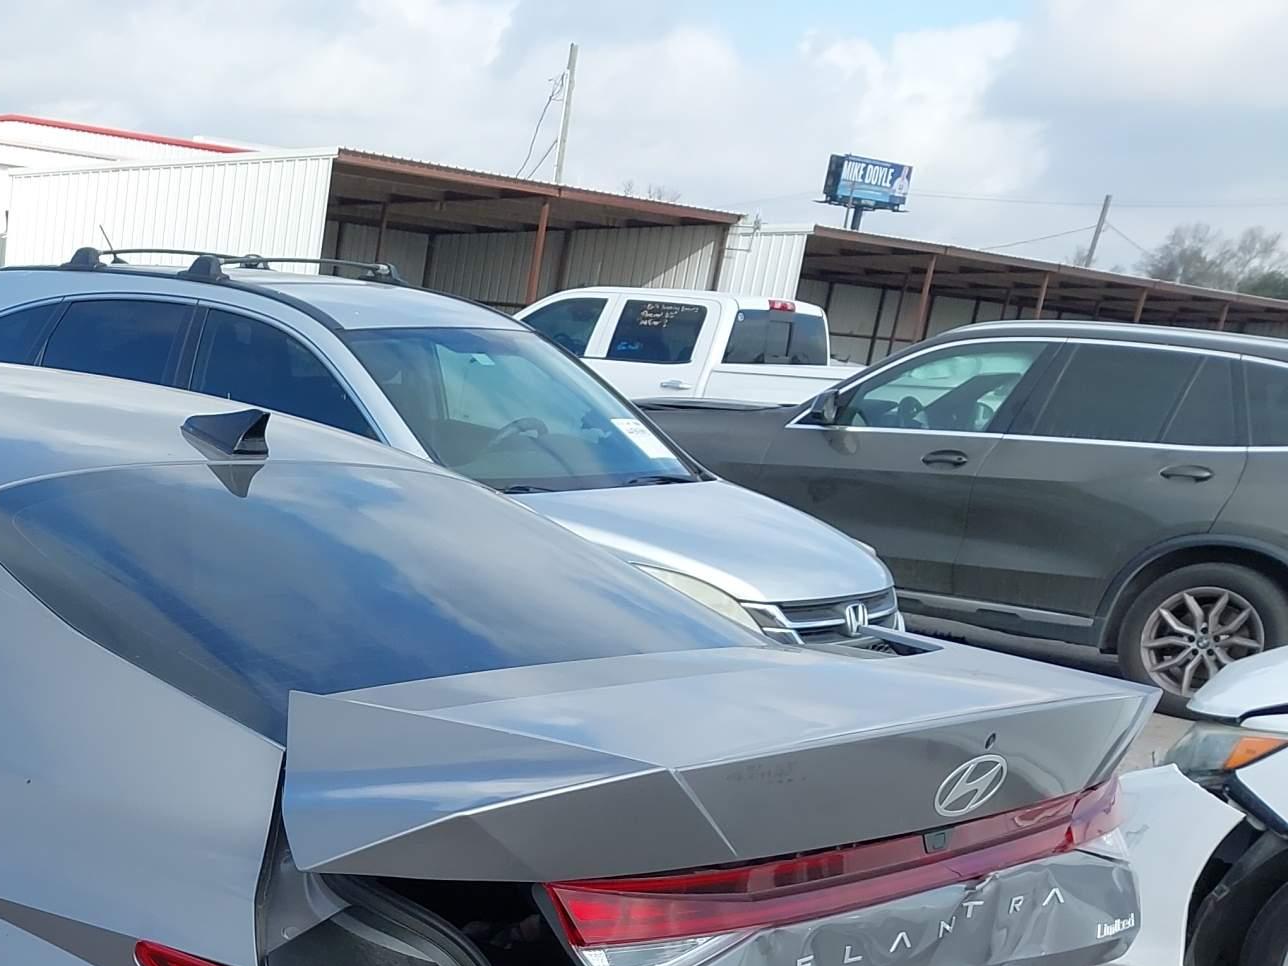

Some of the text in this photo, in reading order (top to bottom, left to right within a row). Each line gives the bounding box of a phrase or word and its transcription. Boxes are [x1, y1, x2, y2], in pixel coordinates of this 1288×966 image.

[841, 160, 867, 183] MIKE
[864, 164, 895, 188] DOYLE
[1096, 912, 1135, 939] Limited
